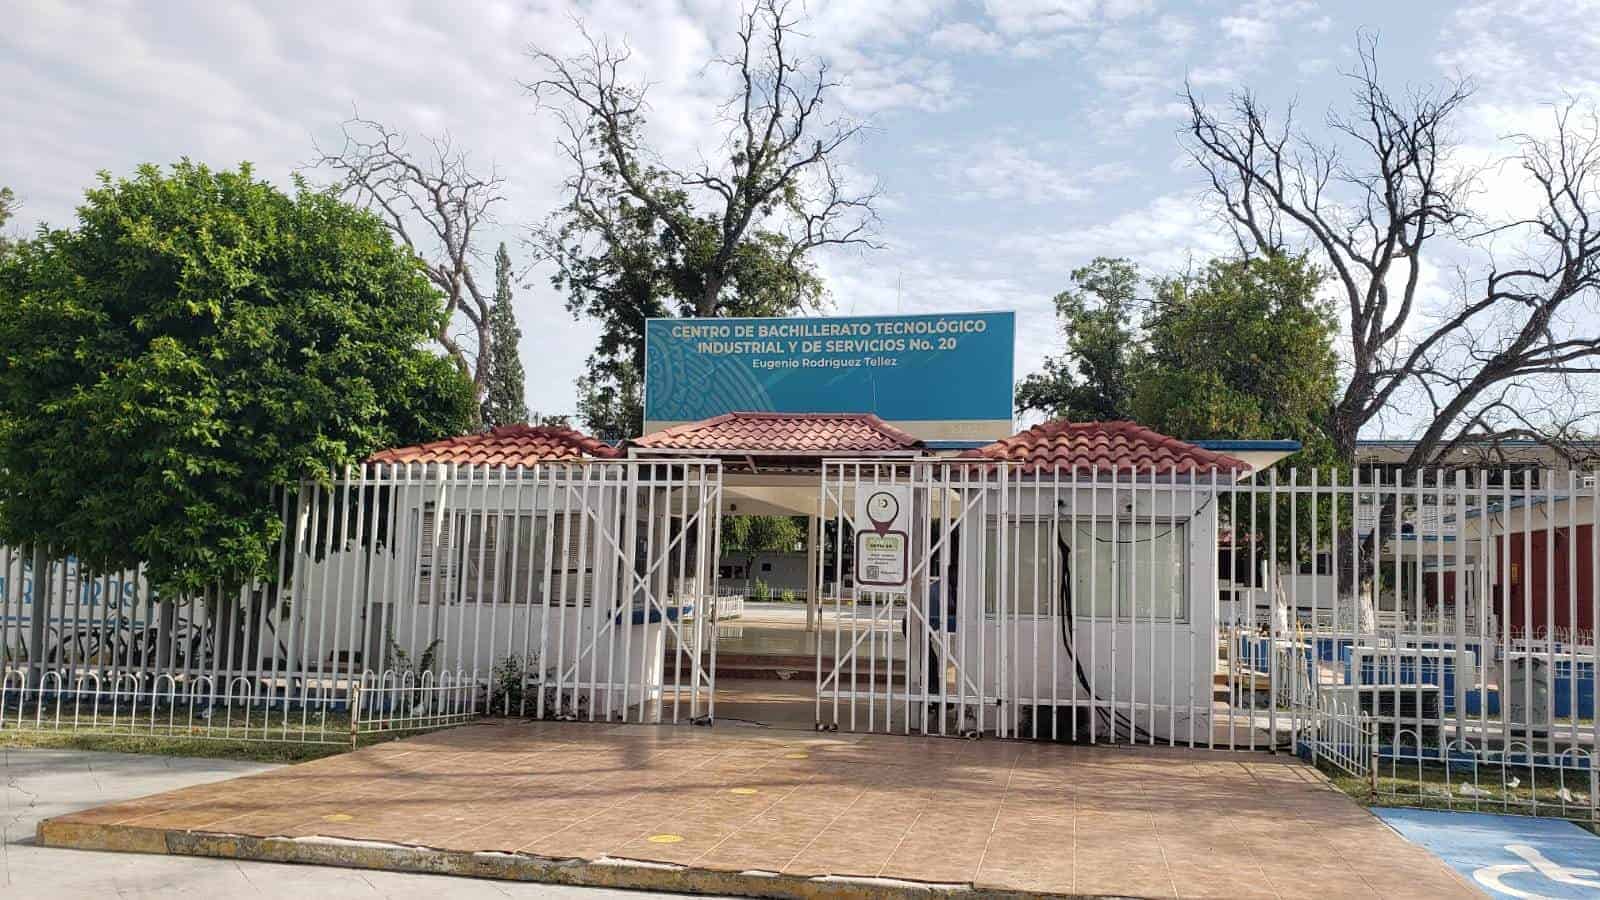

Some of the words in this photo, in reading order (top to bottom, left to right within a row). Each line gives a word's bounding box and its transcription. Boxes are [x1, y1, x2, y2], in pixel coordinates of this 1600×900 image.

[672, 325, 730, 338] CENTRO
[735, 325, 754, 337] DE
[758, 322, 871, 337] BACHILLERATO
[875, 317, 987, 335] TECNOLÓGICO
[697, 341, 785, 354] INDUSTRIAL
[788, 341, 797, 353] Y
[802, 340, 822, 353] DE
[826, 338, 905, 353] SERVICIOS
[909, 337, 934, 351] No.
[938, 337, 957, 350] 20
[752, 358, 800, 370] Eugenio
